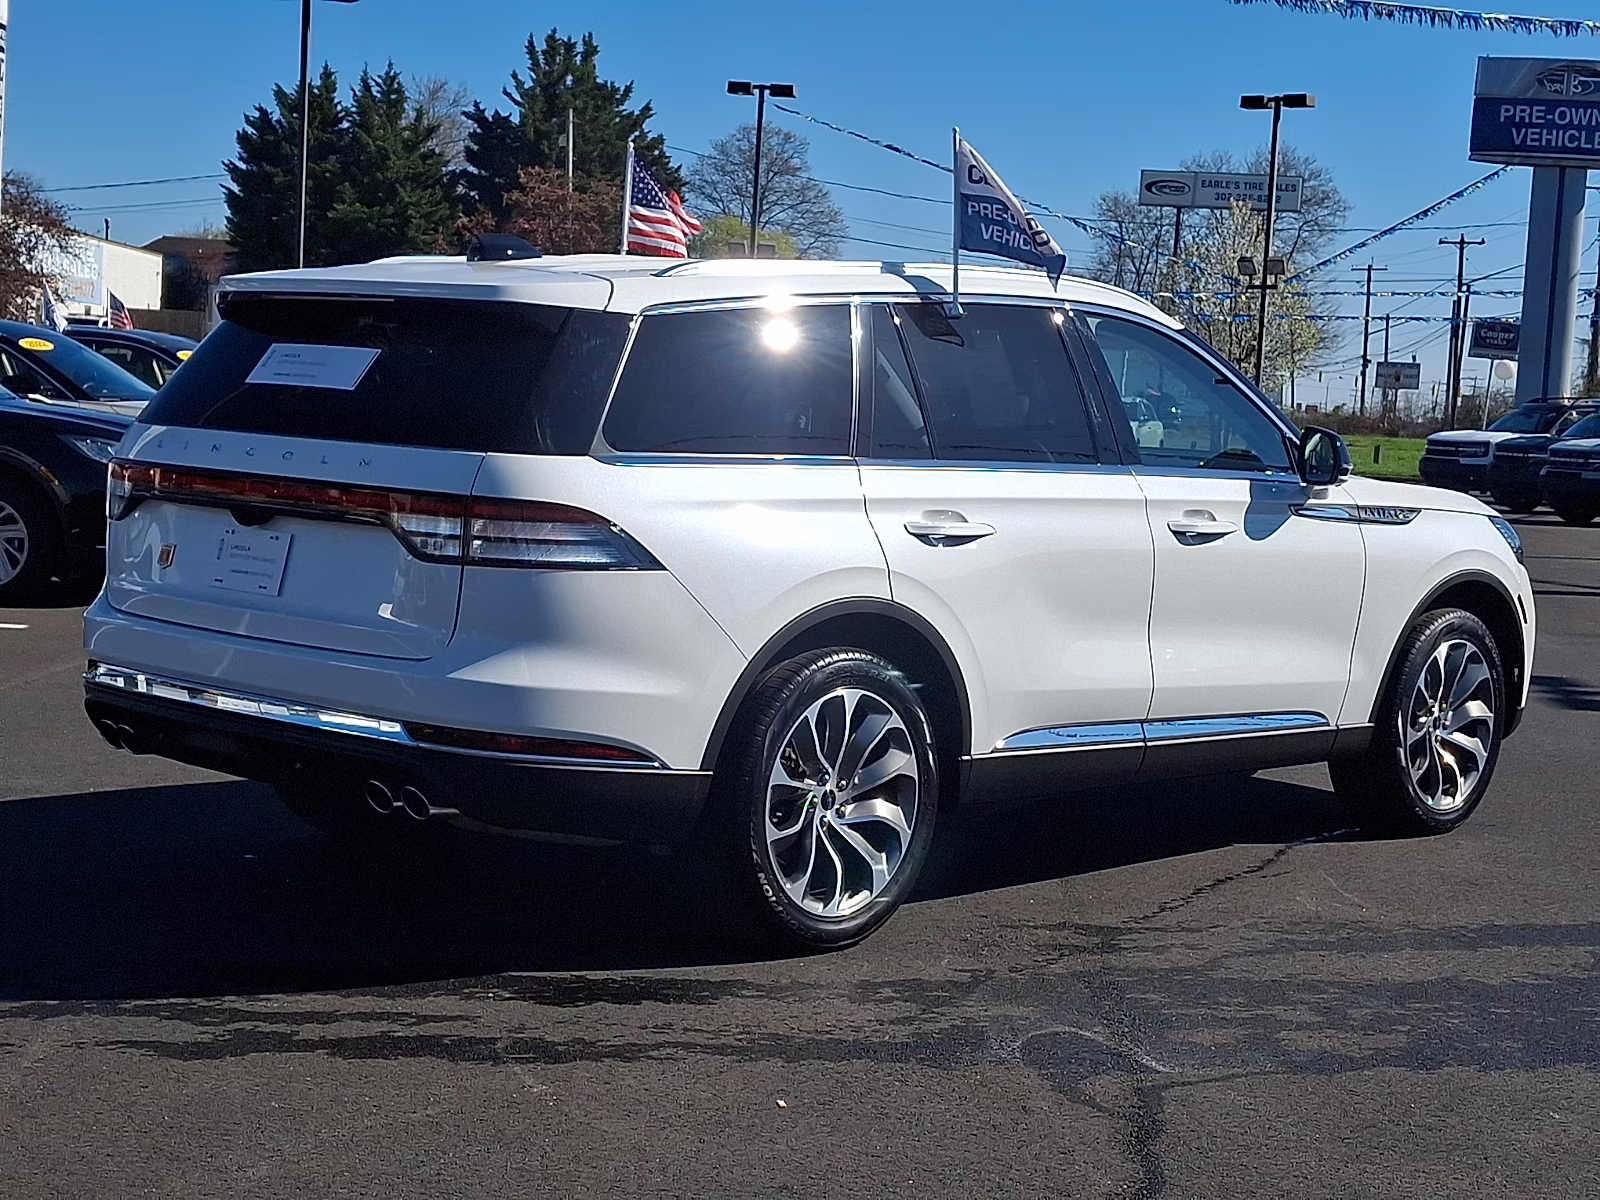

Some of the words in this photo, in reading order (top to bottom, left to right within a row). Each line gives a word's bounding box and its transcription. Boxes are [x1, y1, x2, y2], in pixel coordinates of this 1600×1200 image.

[1500, 104, 1600, 126] PRE-OWN
[1201, 179, 1240, 189] EARLE'S
[1244, 182, 1264, 191] TIRE
[1268, 183, 1297, 193] LES
[967, 201, 1026, 230] PRE-O
[1480, 328, 1516, 344] Cooper
[157, 439, 372, 468] LINCOLN
